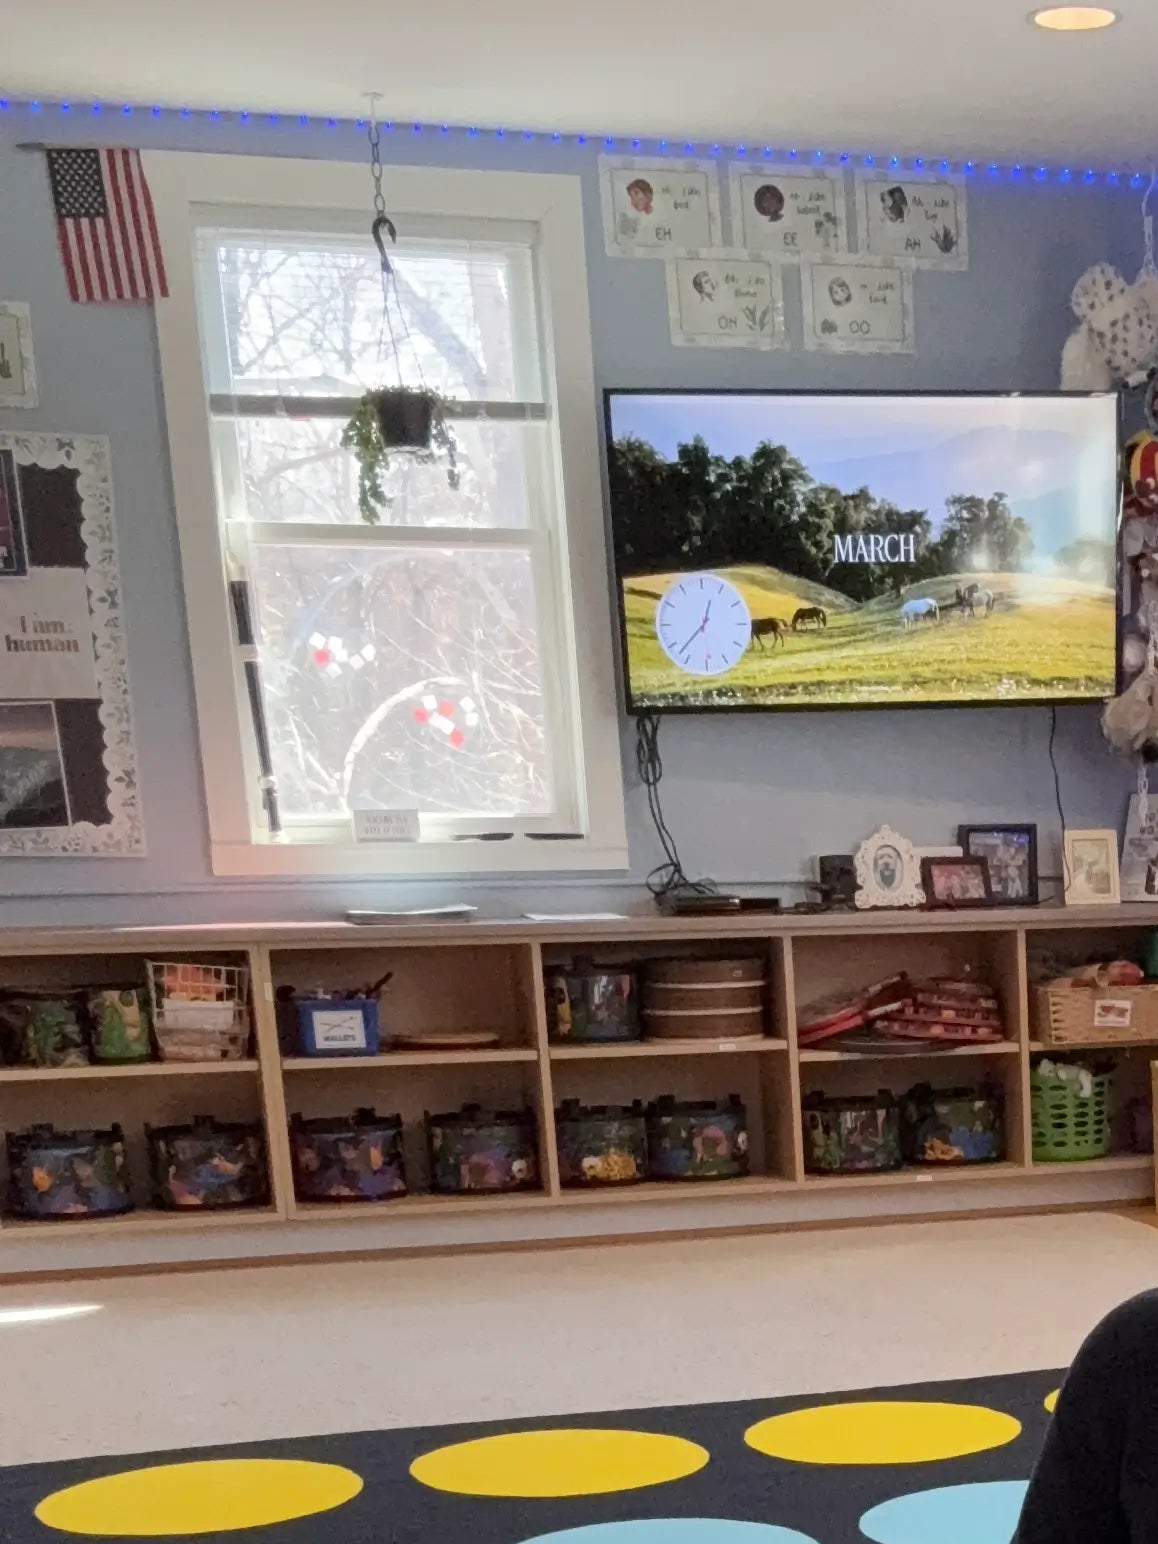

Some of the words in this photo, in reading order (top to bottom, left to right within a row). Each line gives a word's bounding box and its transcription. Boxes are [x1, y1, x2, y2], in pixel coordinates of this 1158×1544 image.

[655, 227, 672, 241] EH
[834, 533, 916, 563] MARCH
[5, 634, 80, 652] human
